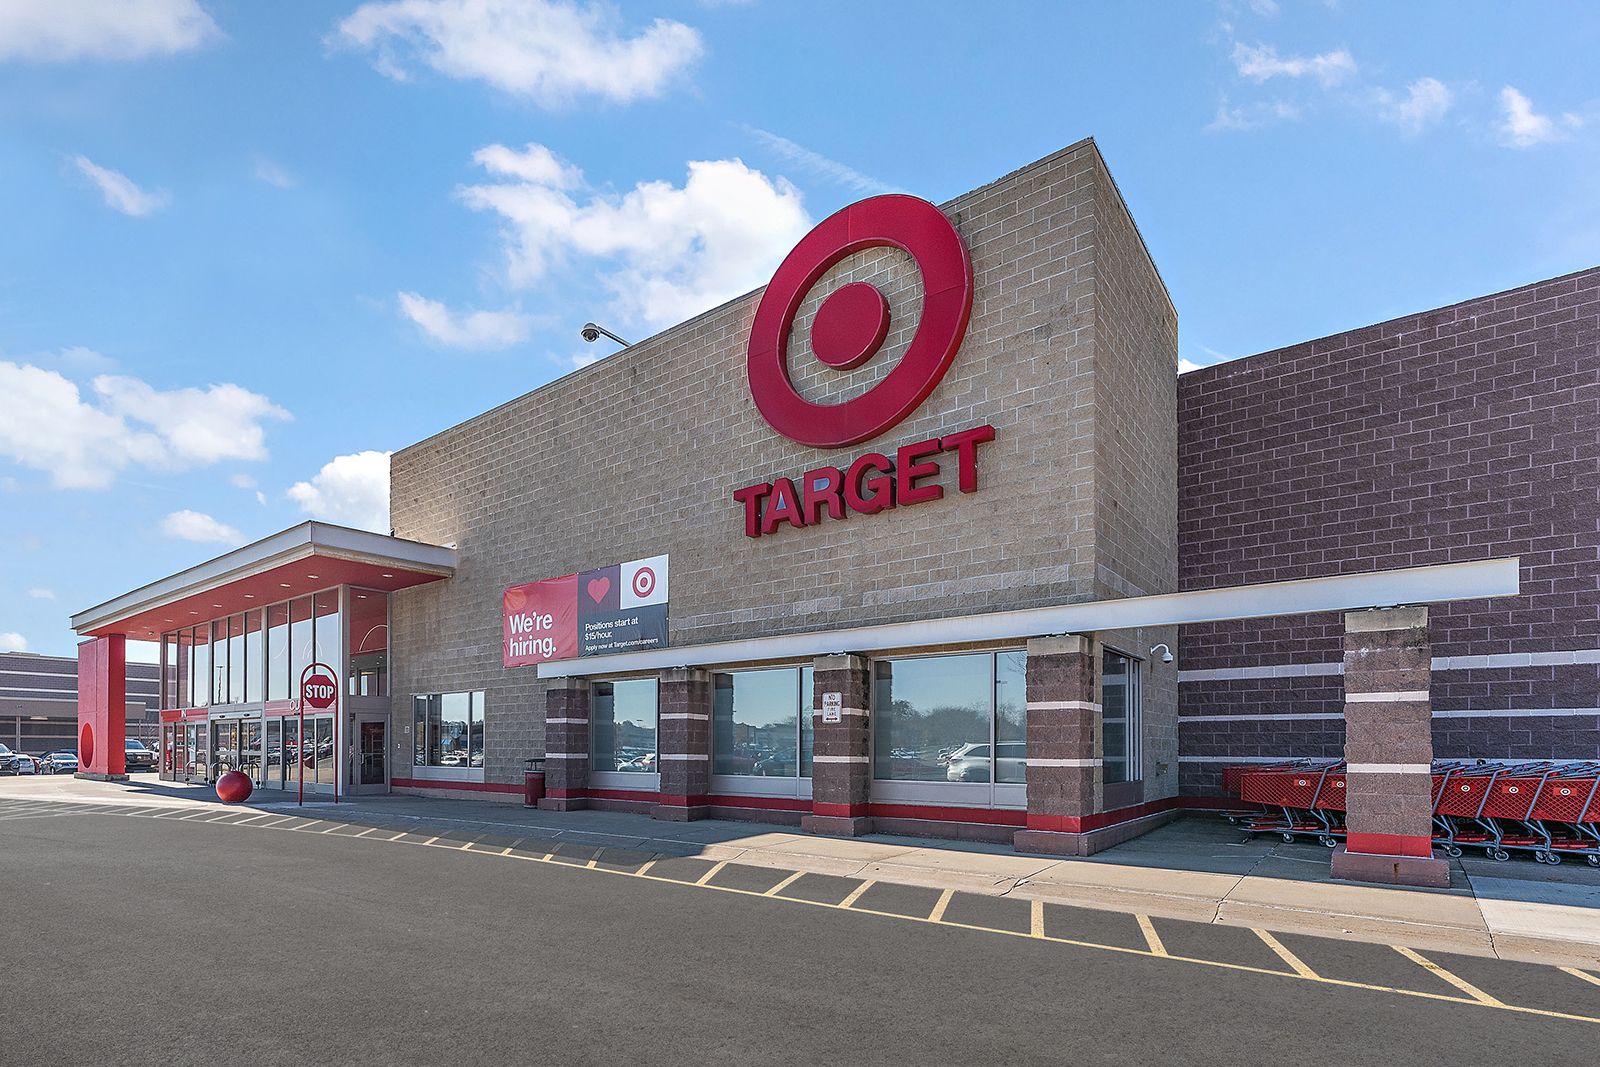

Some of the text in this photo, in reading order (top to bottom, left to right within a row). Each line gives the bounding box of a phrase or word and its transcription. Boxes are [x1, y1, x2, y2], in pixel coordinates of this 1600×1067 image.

[733, 424, 996, 538] TARGET
[508, 611, 553, 635] We're
[585, 616, 639, 631] Positions start at
[509, 635, 557, 658] hiring.
[585, 644, 598, 652] Apply
[613, 637, 659, 649] Target.com/careers
[305, 684, 334, 699] STOP
